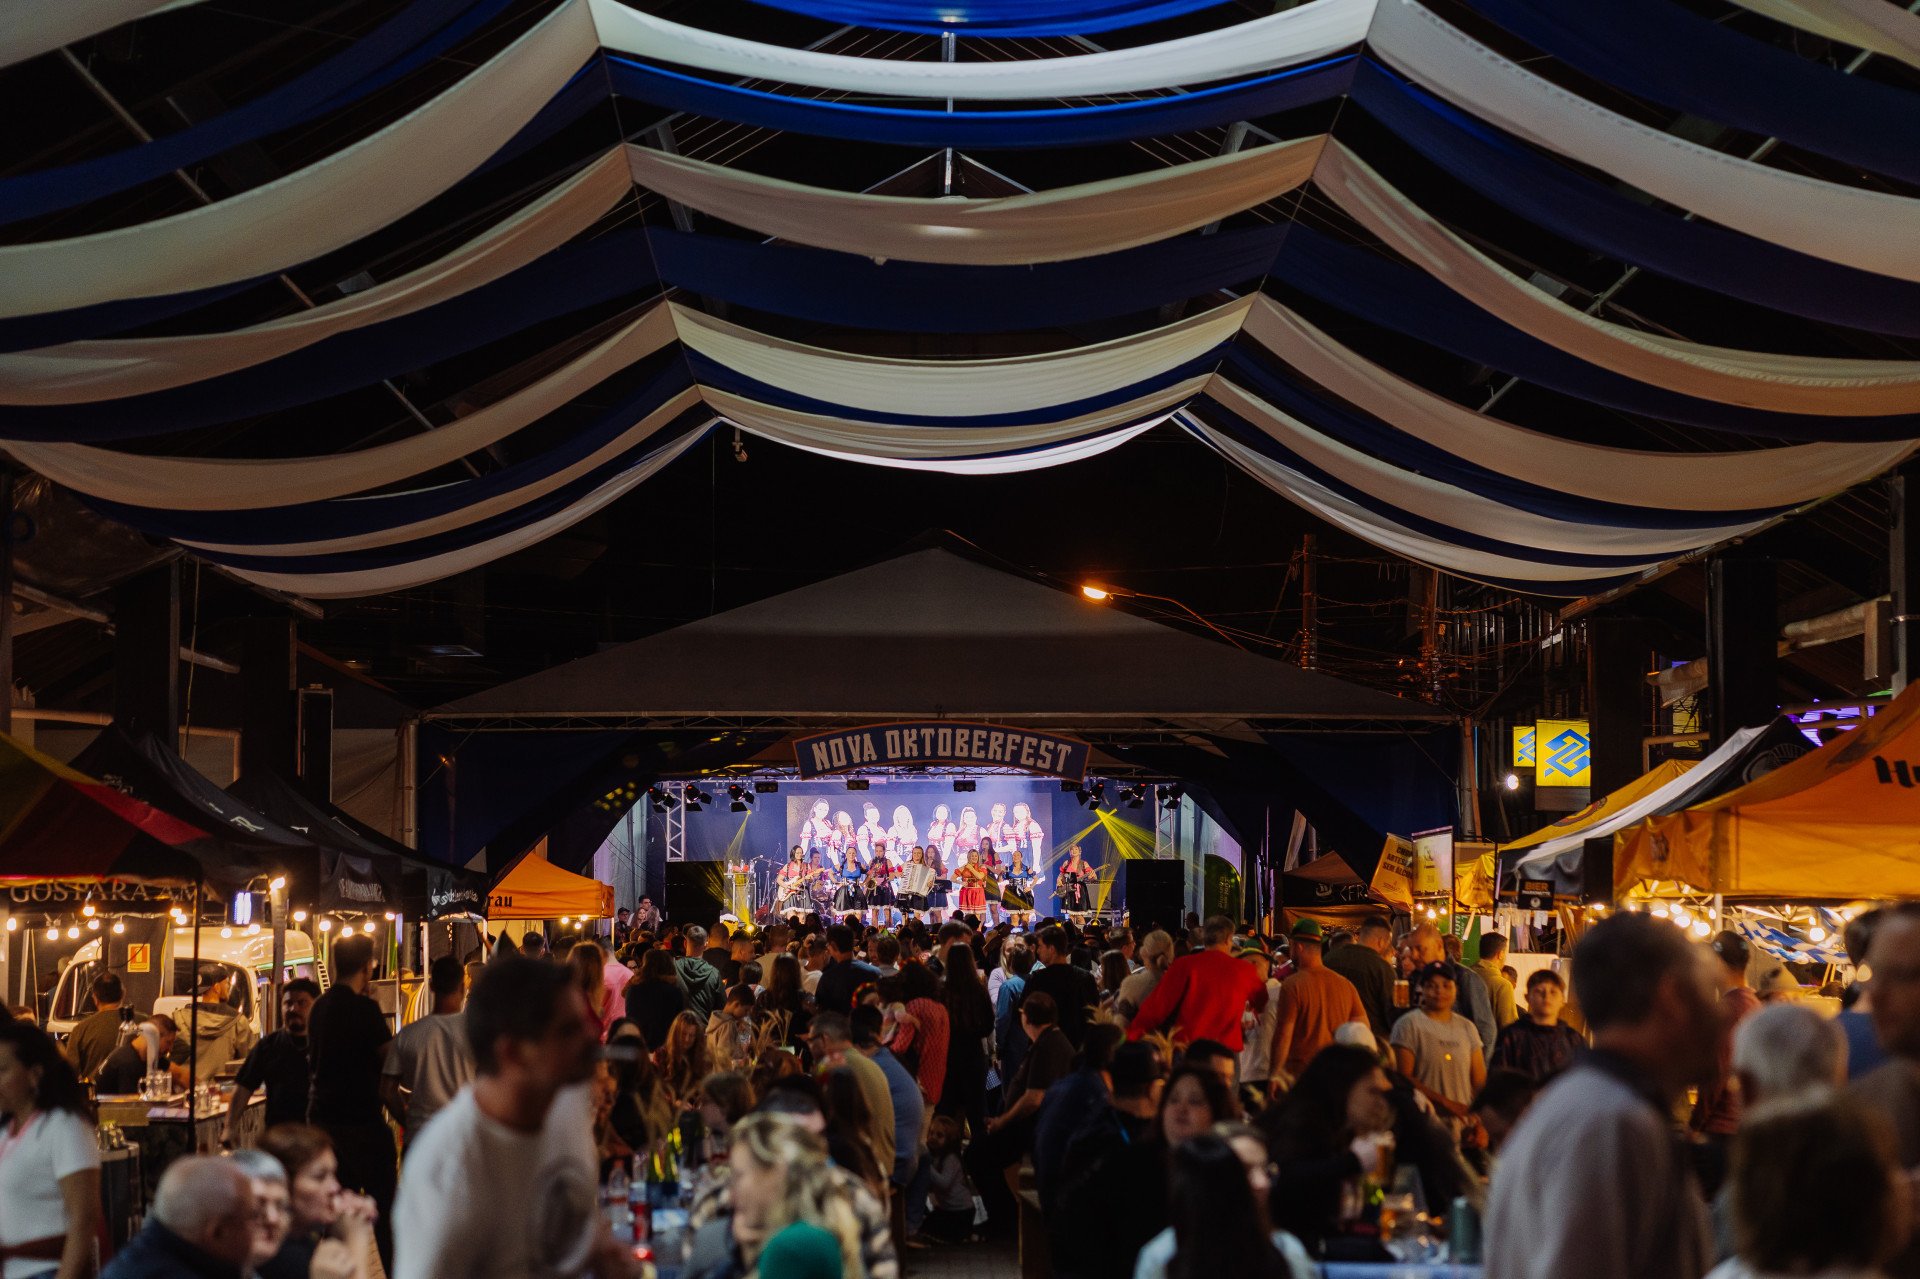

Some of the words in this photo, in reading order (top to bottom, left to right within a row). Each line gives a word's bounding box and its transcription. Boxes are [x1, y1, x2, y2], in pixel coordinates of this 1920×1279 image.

[811, 732, 878, 772] NOVA
[885, 727, 1072, 773] OKTOBERFEST
[487, 895, 513, 908] rau
